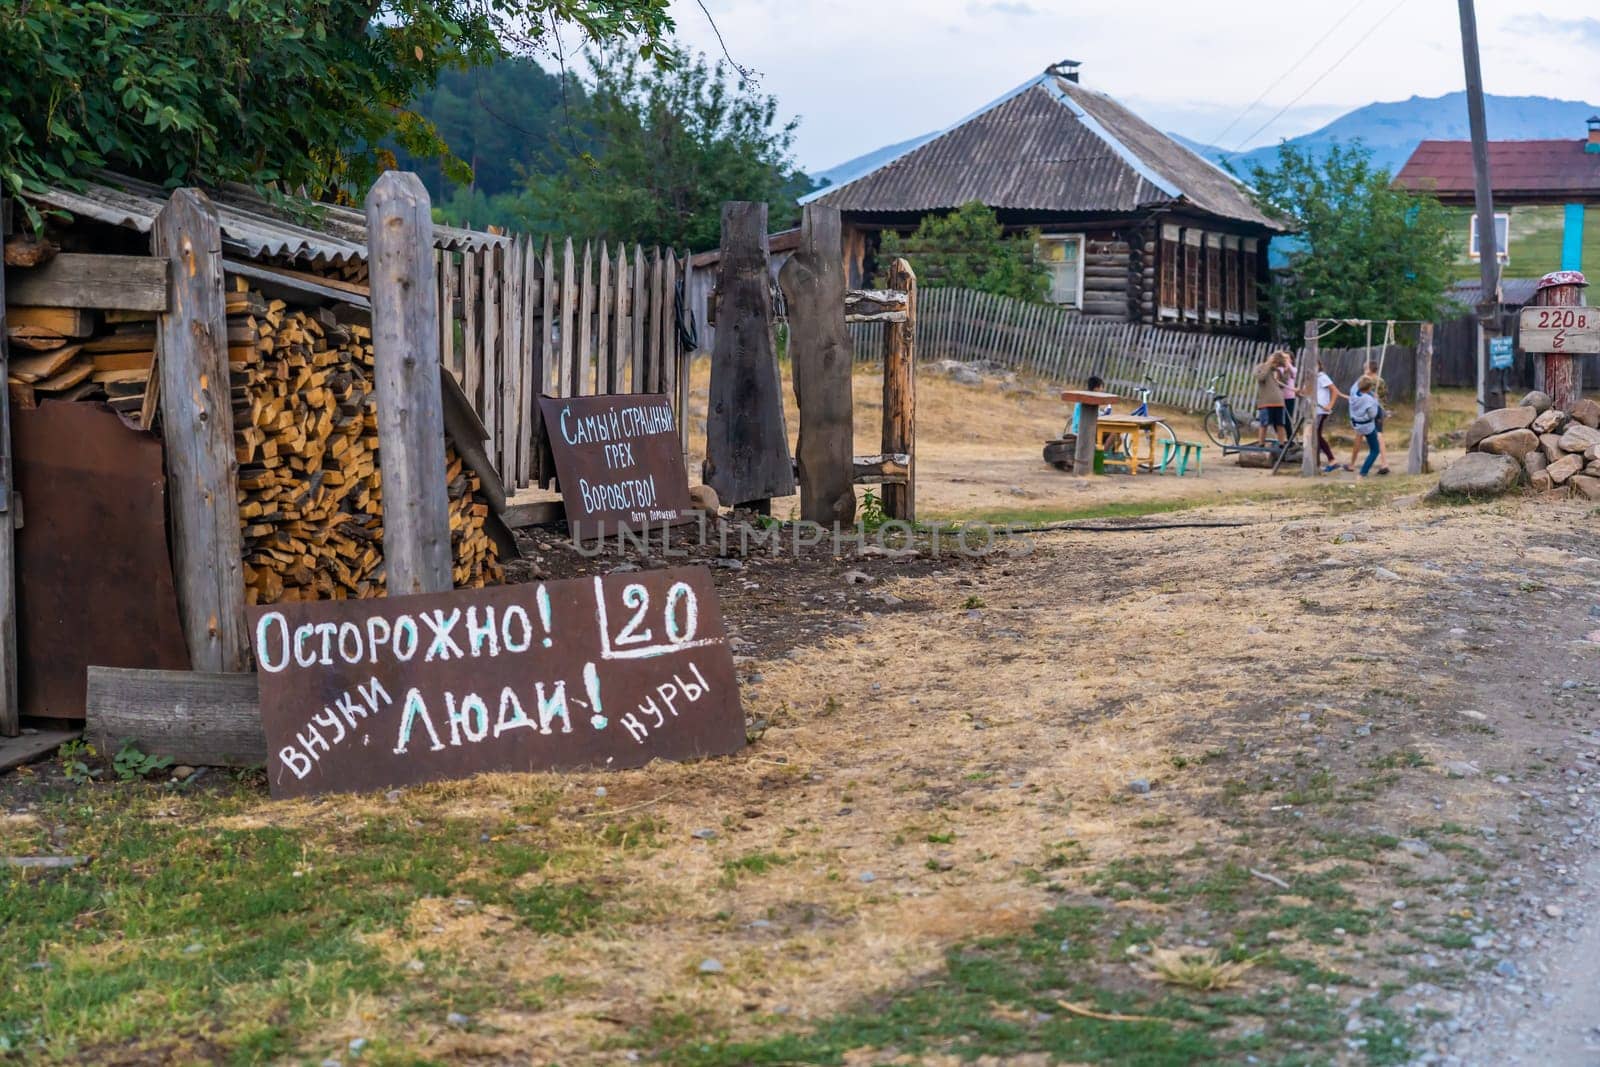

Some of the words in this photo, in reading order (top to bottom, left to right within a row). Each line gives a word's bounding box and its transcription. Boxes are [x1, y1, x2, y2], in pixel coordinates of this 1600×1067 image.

[1538, 310, 1574, 328] 220
[604, 443, 635, 469] ГРЕХ
[256, 584, 552, 672] ОСТОРОЖНО!
[615, 582, 698, 645] 20
[278, 676, 392, 780] ВНУКИ
[393, 662, 608, 754] ЛЮДИ!
[620, 662, 710, 744] КУРЫ
